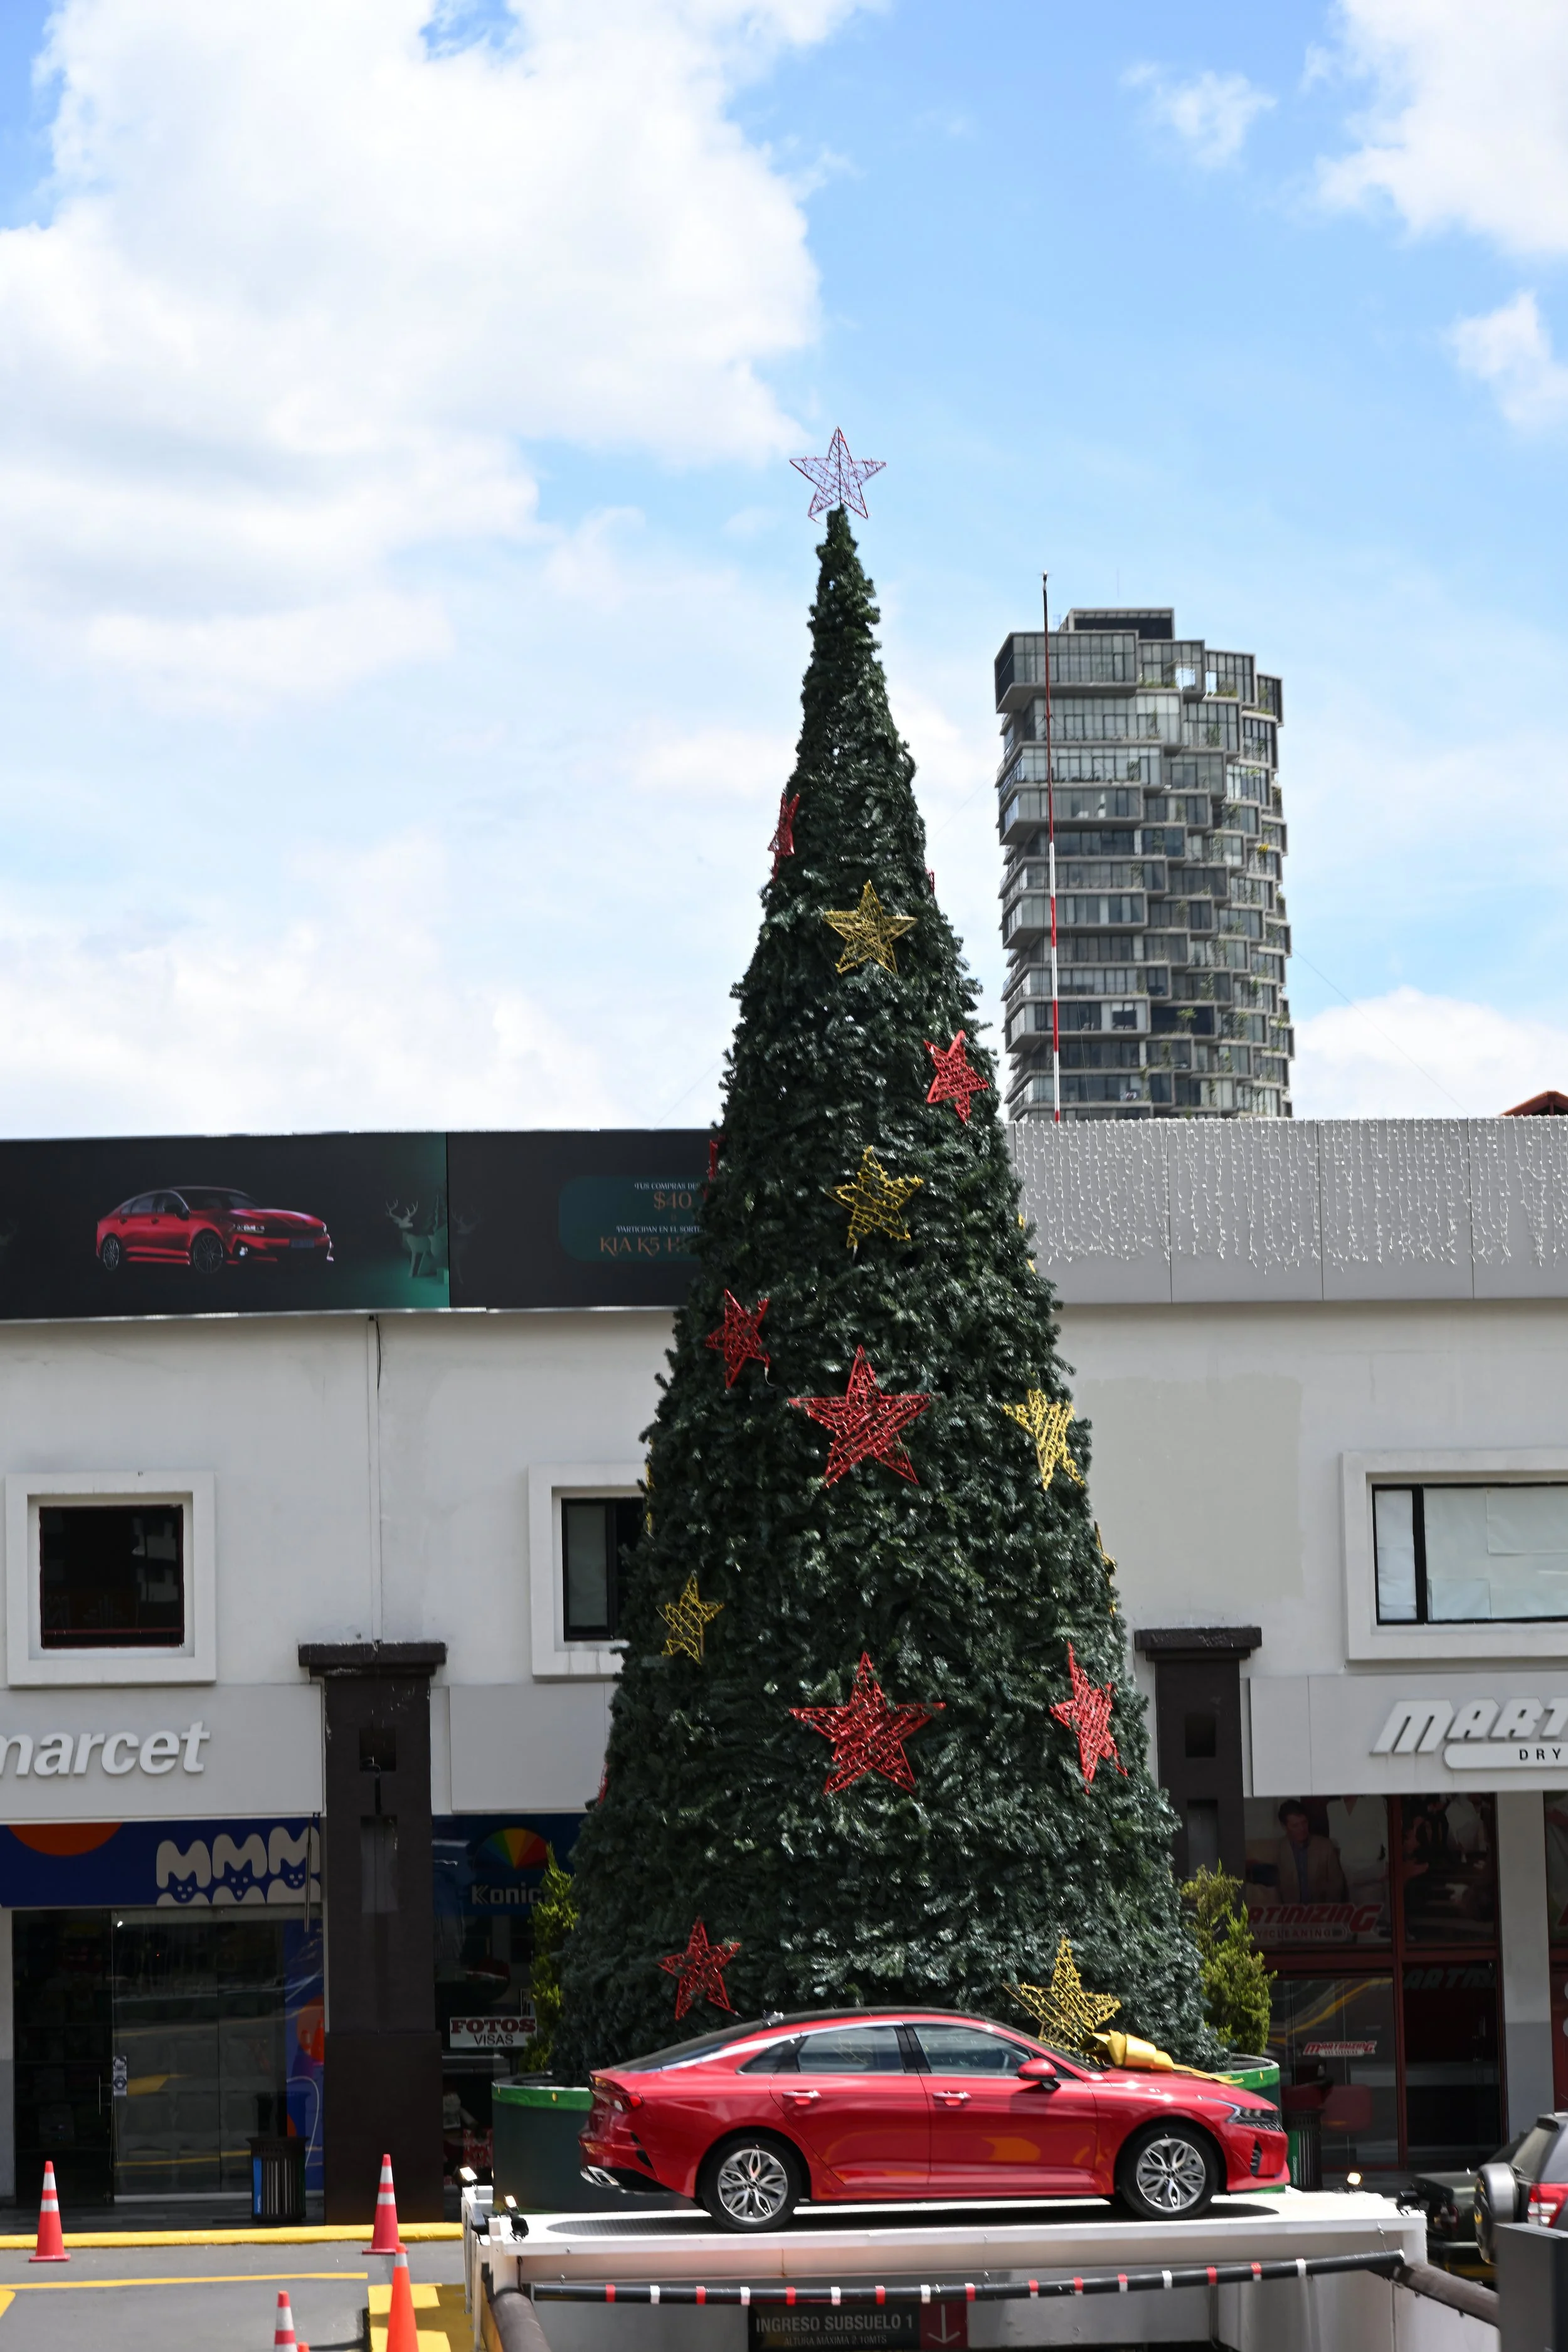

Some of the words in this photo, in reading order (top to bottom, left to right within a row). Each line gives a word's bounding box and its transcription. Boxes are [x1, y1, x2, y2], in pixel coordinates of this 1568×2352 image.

[654, 1190, 692, 1211] $40
[616, 1225, 657, 1233] PARTICIPAN
[600, 1236, 632, 1257] KIA
[638, 1236, 660, 1257] K5
[1519, 1748, 1562, 1761] DRY
[472, 1882, 547, 1905] Konic
[451, 2018, 536, 2033] FOTOS
[474, 2033, 514, 2045] VISAS
[756, 2316, 820, 2333] INGRESO
[824, 2314, 902, 2331] SUBSUELO
[905, 2314, 913, 2329] 1
[783, 2336, 815, 2347] ALTURA
